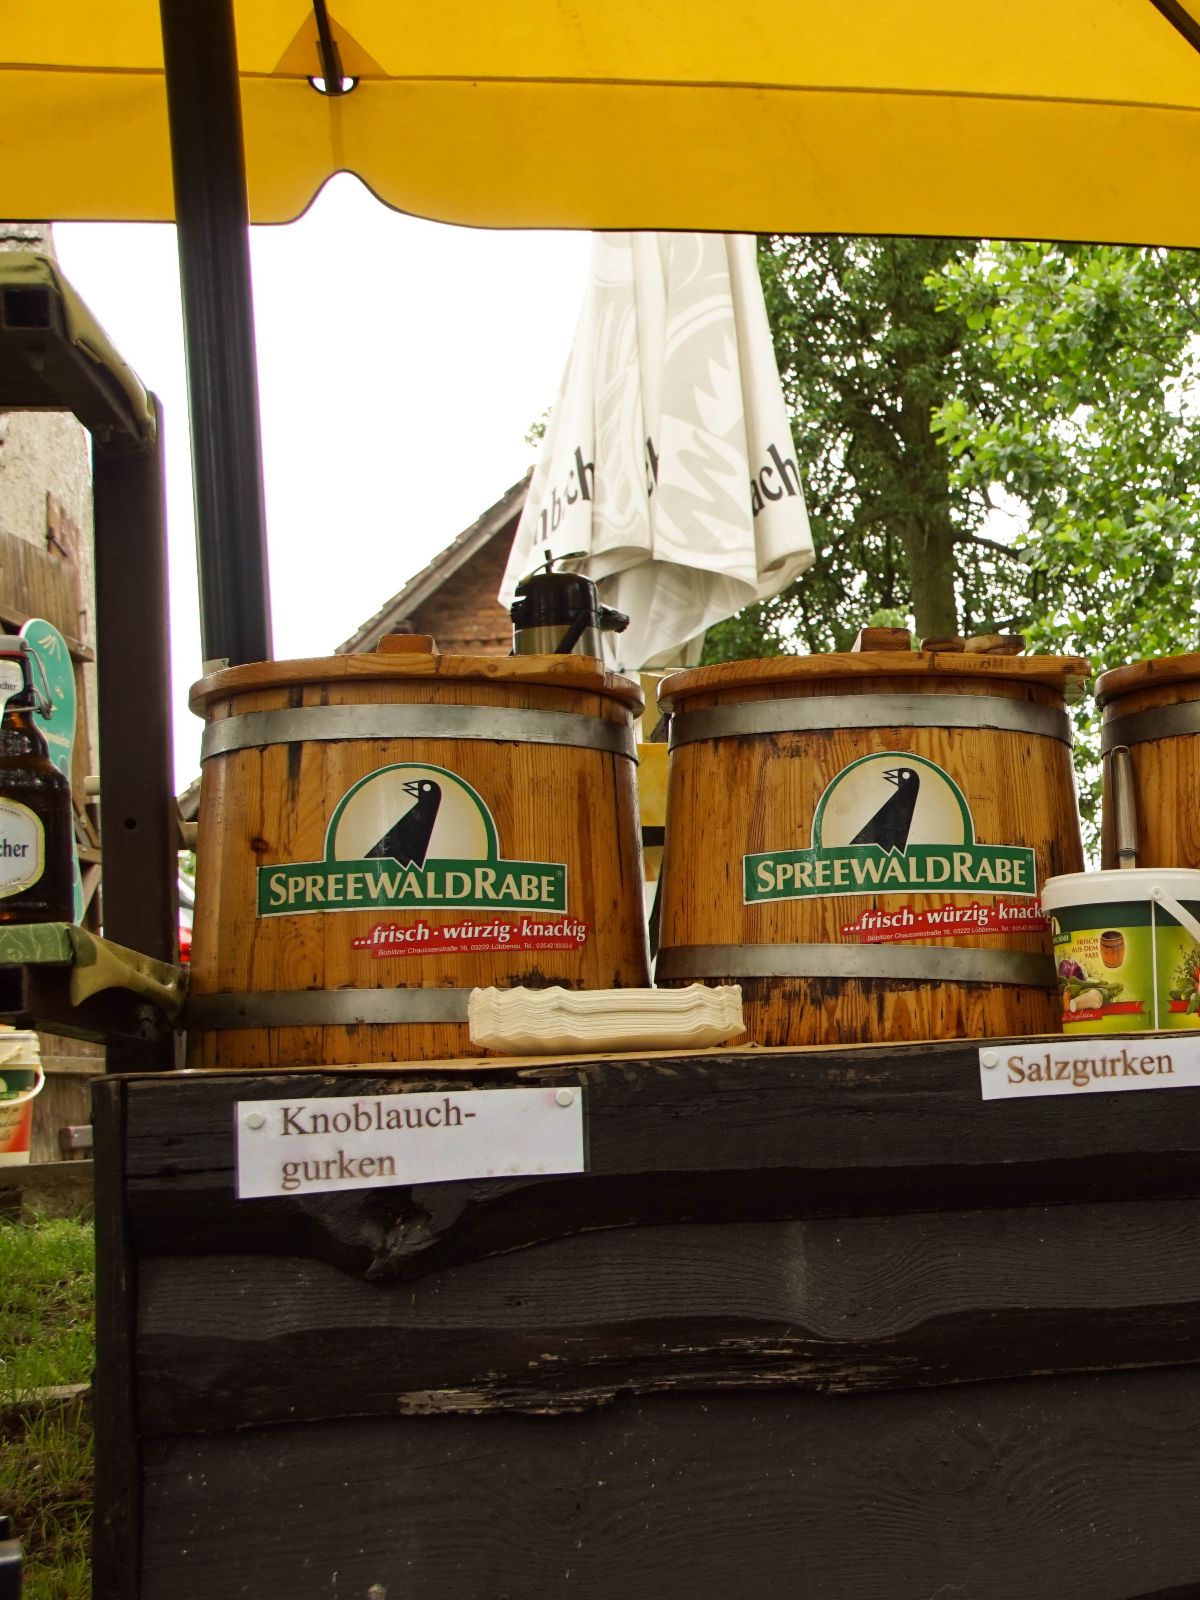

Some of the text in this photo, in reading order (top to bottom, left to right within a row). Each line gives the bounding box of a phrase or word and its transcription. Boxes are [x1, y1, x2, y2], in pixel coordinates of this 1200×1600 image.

[268, 867, 556, 907] SPREEWALDRABE
[757, 852, 1027, 893] SPREEWALDRABE
[443, 922, 511, 942] würzig
[521, 919, 587, 942] knackig
[927, 904, 989, 925] würzig
[1000, 902, 1051, 924] knack
[1007, 1049, 1175, 1087] Salzgurken
[280, 1097, 476, 1137] Knoblauch-
[281, 1151, 398, 1191] gurken
